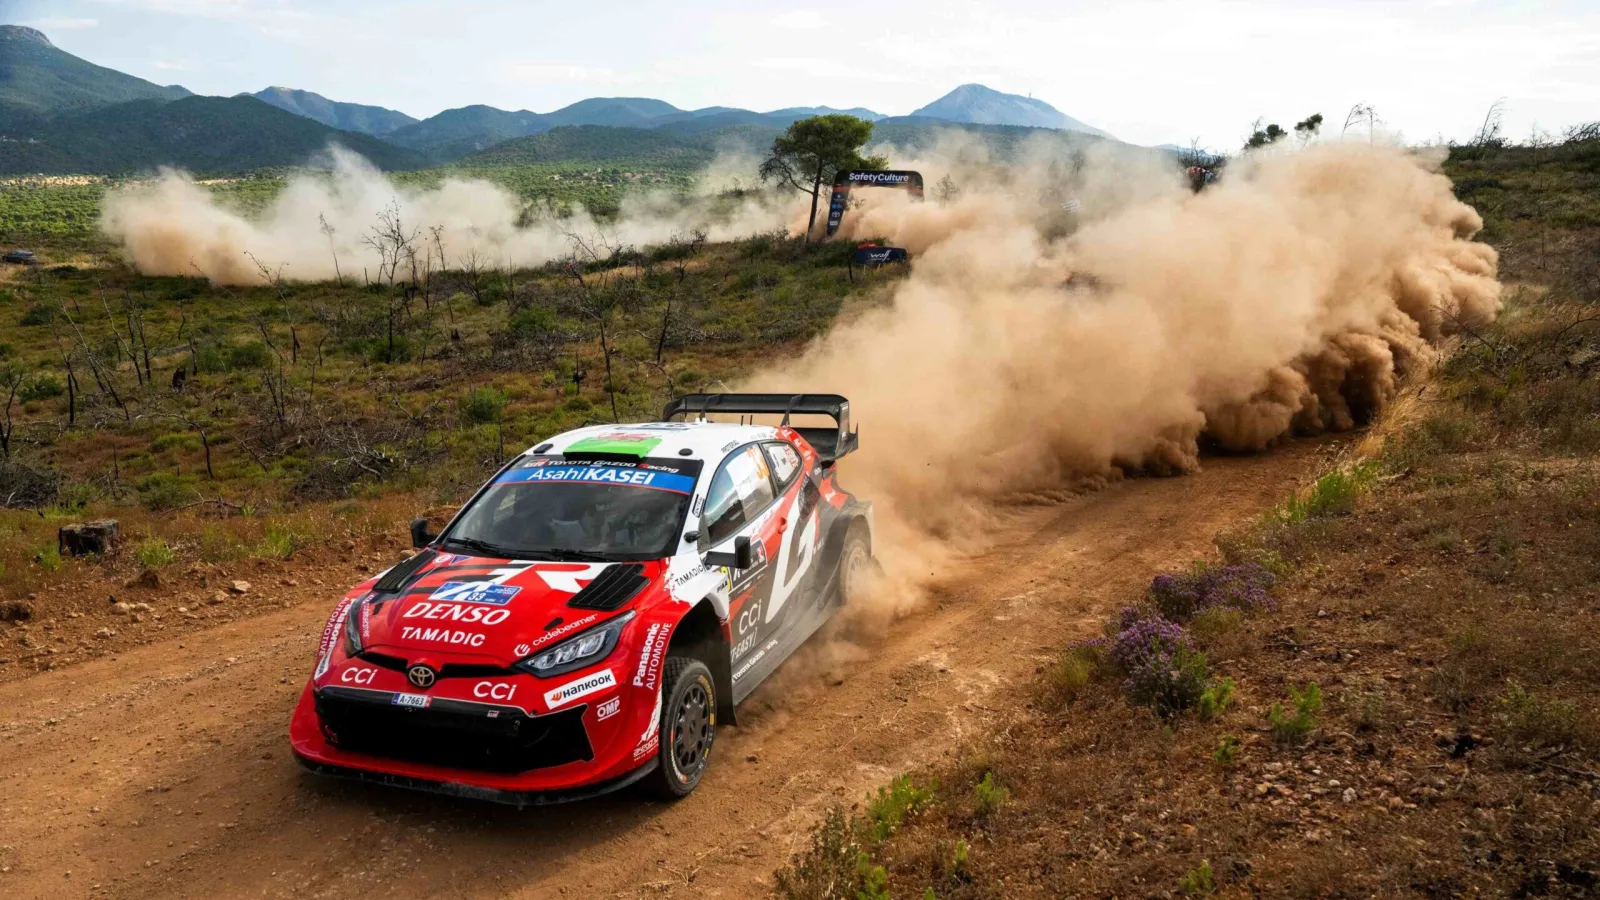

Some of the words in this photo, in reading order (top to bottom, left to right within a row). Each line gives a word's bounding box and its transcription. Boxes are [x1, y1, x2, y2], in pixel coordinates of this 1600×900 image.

[849, 172, 909, 182] SafetyCulture
[527, 468, 655, 485] AsahiKASEI
[638, 463, 680, 473] Racing
[674, 564, 704, 587] TAMADIC
[467, 592, 487, 600] 33
[403, 602, 511, 625] DENSO
[739, 598, 762, 635] CCi
[319, 596, 348, 657] AUTOMOTIVE
[532, 614, 597, 646] codebeamer
[401, 627, 485, 647] TAMADIC
[633, 622, 660, 687] Panasonic
[646, 622, 672, 690] AUTOMOTIVE
[341, 667, 378, 684] CCi
[400, 695, 425, 705] A-7663
[473, 681, 517, 700] CCi
[597, 699, 620, 717] OMP
